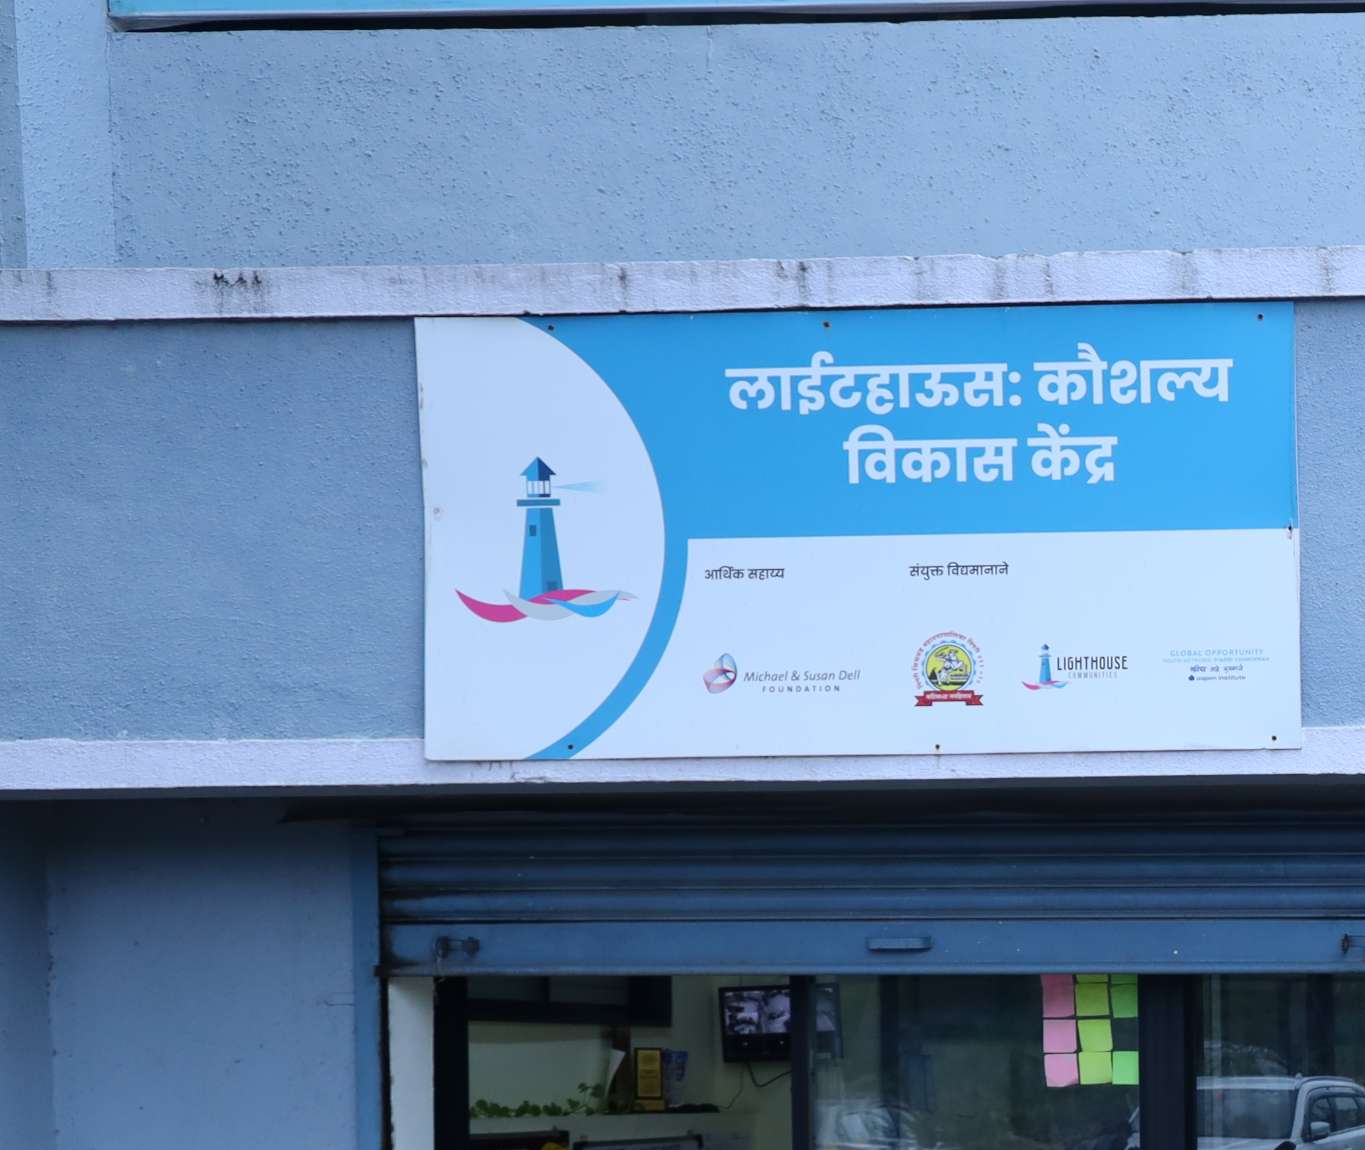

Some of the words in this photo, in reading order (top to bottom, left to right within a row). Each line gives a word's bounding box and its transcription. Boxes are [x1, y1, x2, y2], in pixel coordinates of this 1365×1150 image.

[725, 351, 1021, 414] लाईटहाऊस:
[1033, 343, 1233, 405] कौशल्य
[843, 425, 1017, 483] विकास
[1027, 423, 1118, 484] केंद्र
[705, 566, 744, 580] आर्थिक
[747, 568, 784, 580] सहाय्य
[909, 563, 944, 580] संयुक्त
[947, 562, 1009, 576] विद्यमानाने
[1057, 656, 1128, 670] LIGHTHOUSE
[744, 670, 788, 682] Michael
[791, 671, 800, 681] &
[803, 671, 836, 681] Susan
[838, 670, 861, 681] Dell
[762, 685, 840, 693] FOUNDATION
